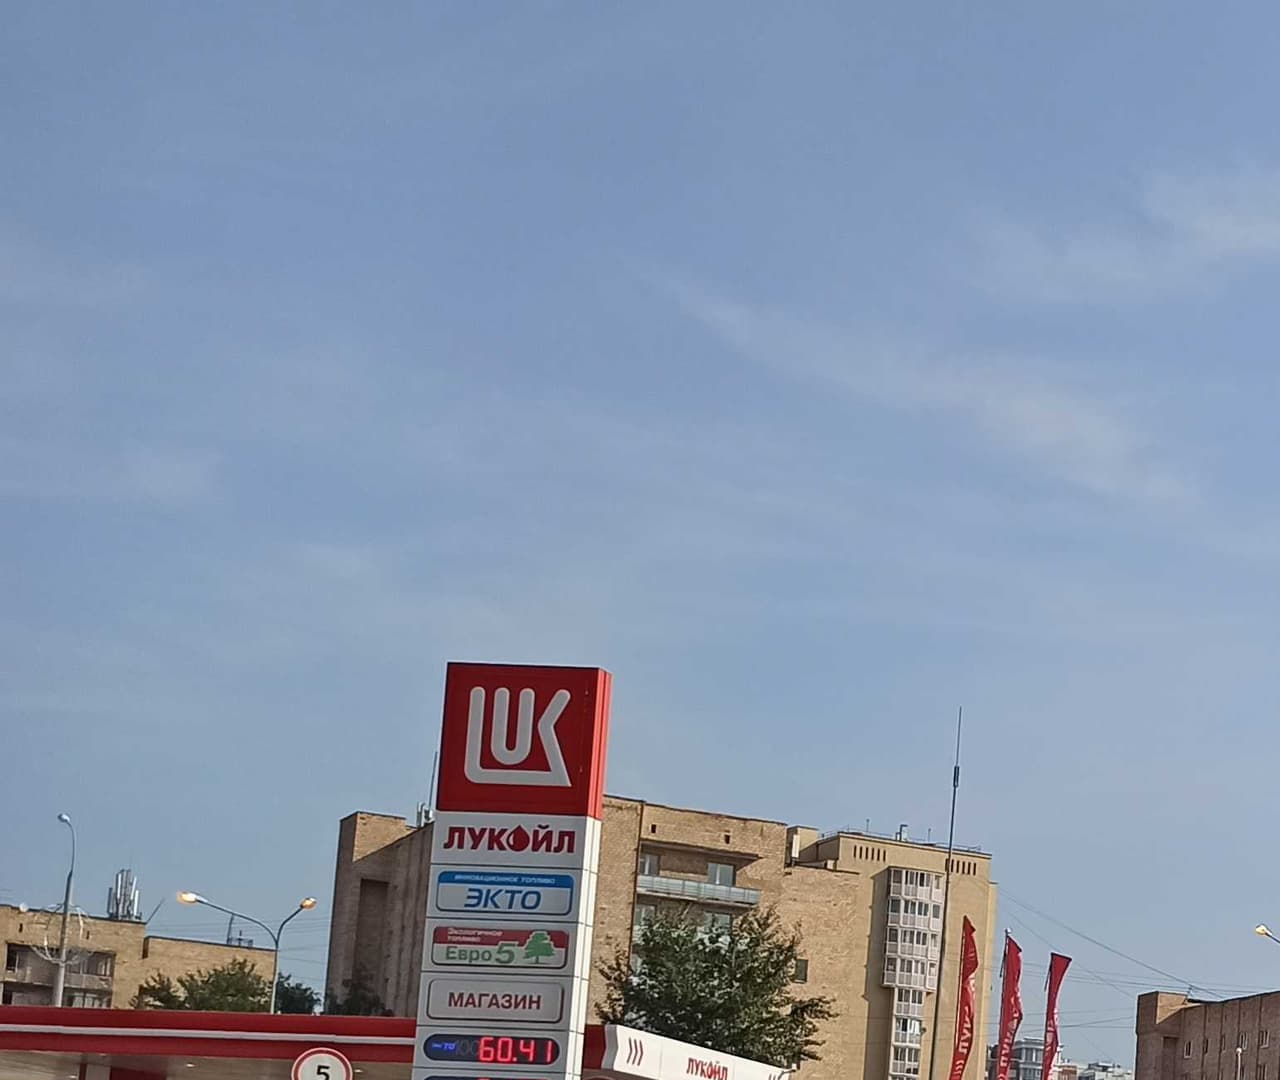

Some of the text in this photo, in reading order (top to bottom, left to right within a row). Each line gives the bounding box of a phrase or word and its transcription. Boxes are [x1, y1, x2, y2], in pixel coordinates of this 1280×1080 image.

[443, 824, 576, 853] ЛУКОЙЛ
[464, 887, 542, 910] ЭКТО
[446, 943, 515, 964] Евро 5
[448, 991, 542, 1010] МАГАЗИН
[479, 1036, 553, 1063] 60.41
